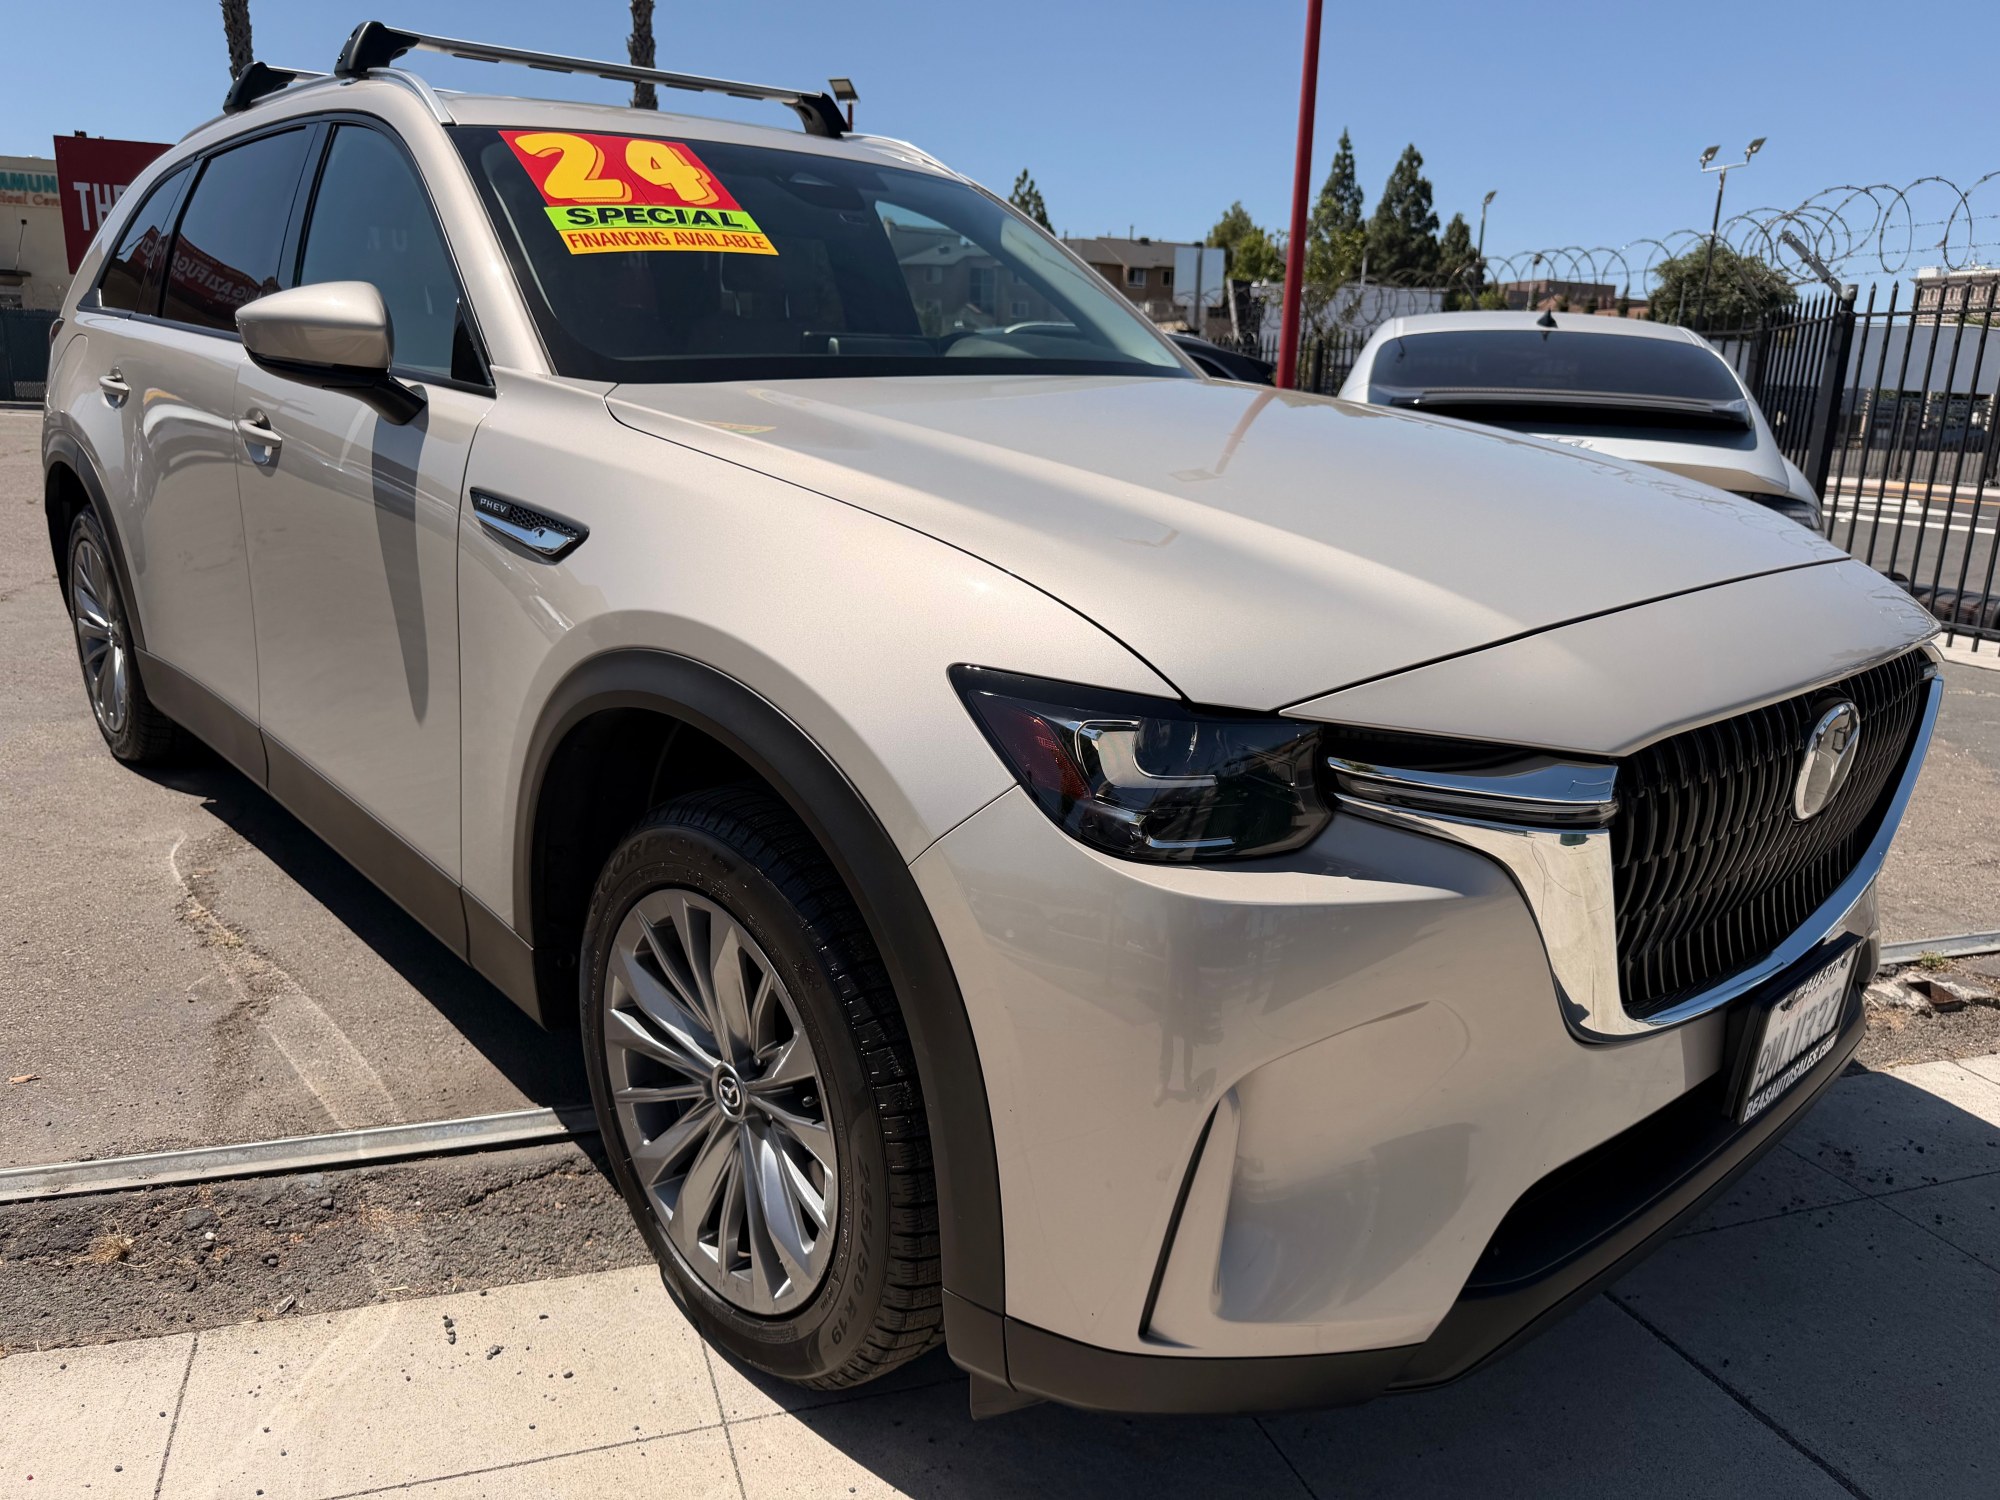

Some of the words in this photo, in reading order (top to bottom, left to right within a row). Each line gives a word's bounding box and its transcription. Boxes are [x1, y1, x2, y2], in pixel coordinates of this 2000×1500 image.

[514, 133, 720, 205] 24
[565, 207, 748, 230] SPECIAL
[568, 232, 669, 249] FINANCING
[676, 233, 768, 250] AVAILABLE
[480, 498, 507, 513] PHEV
[854, 1155, 873, 1296] 255/50
